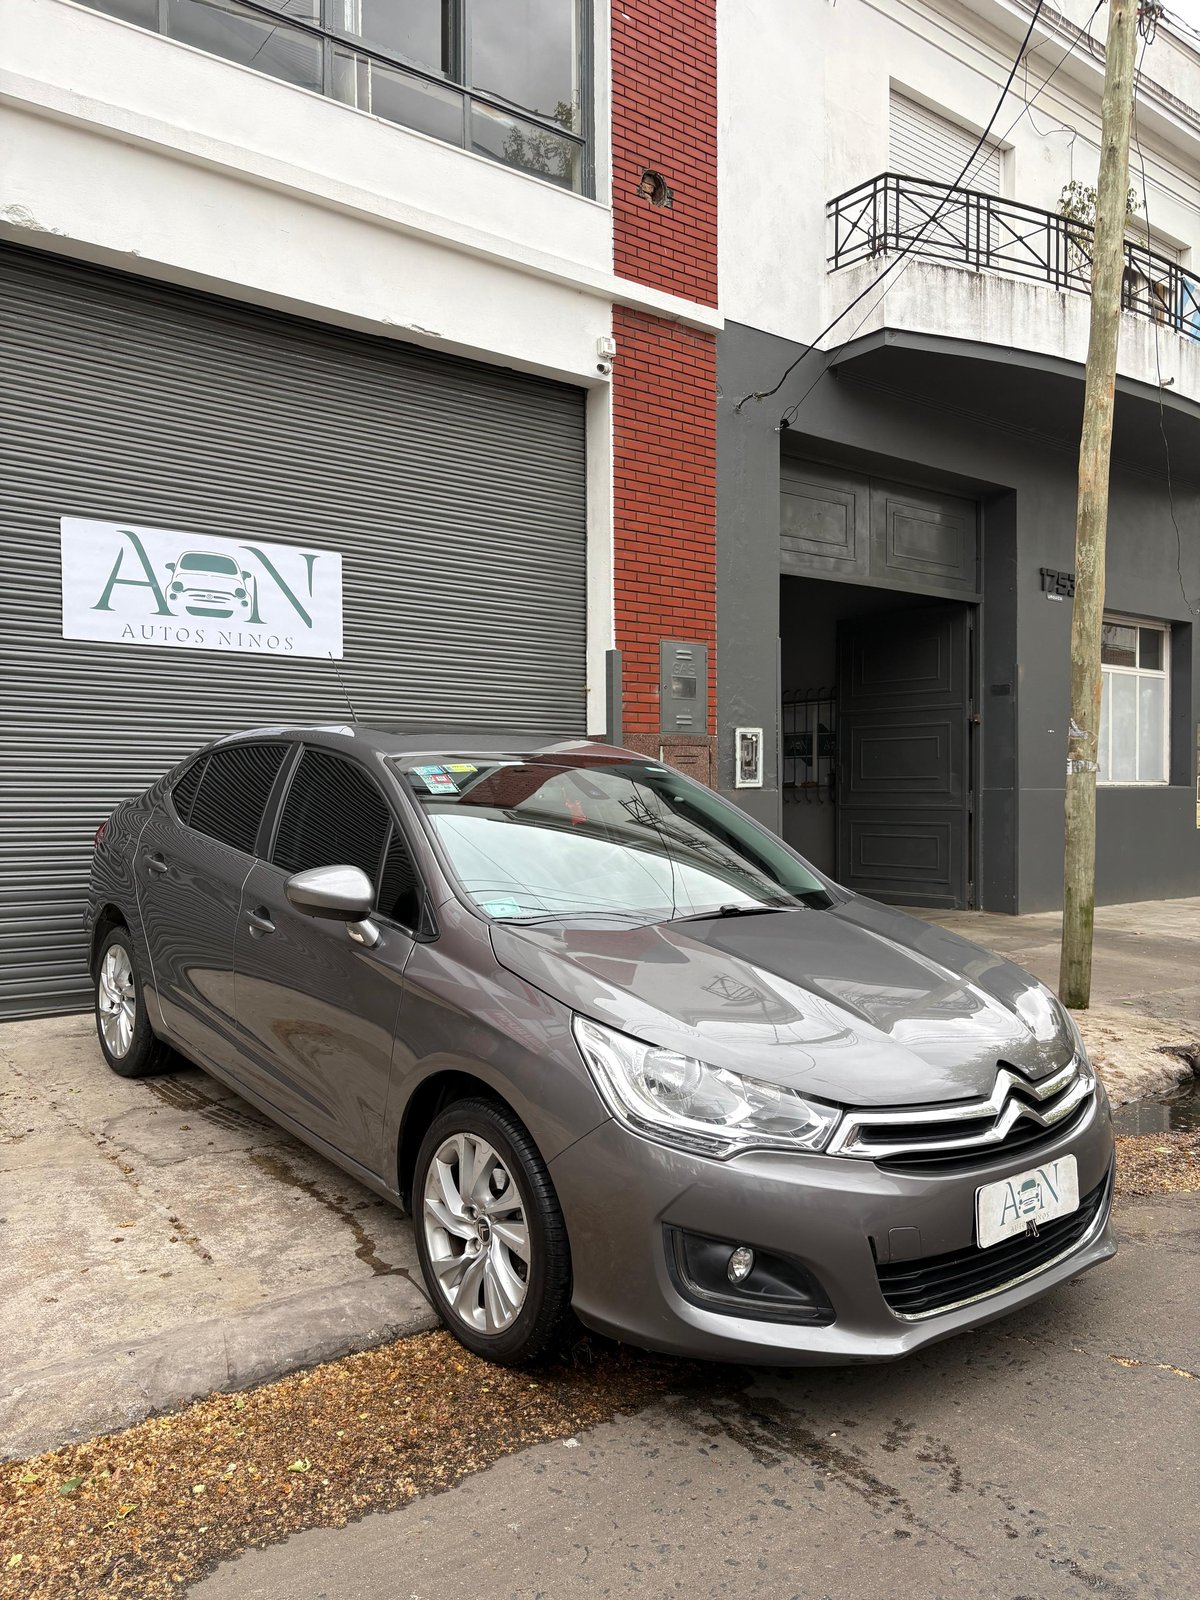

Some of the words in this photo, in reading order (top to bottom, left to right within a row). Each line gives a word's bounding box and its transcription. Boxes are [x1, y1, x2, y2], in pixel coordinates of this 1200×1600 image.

[121, 623, 205, 644] AUTOS
[218, 630, 294, 650] NINOS
[672, 662, 696, 675] GAS
